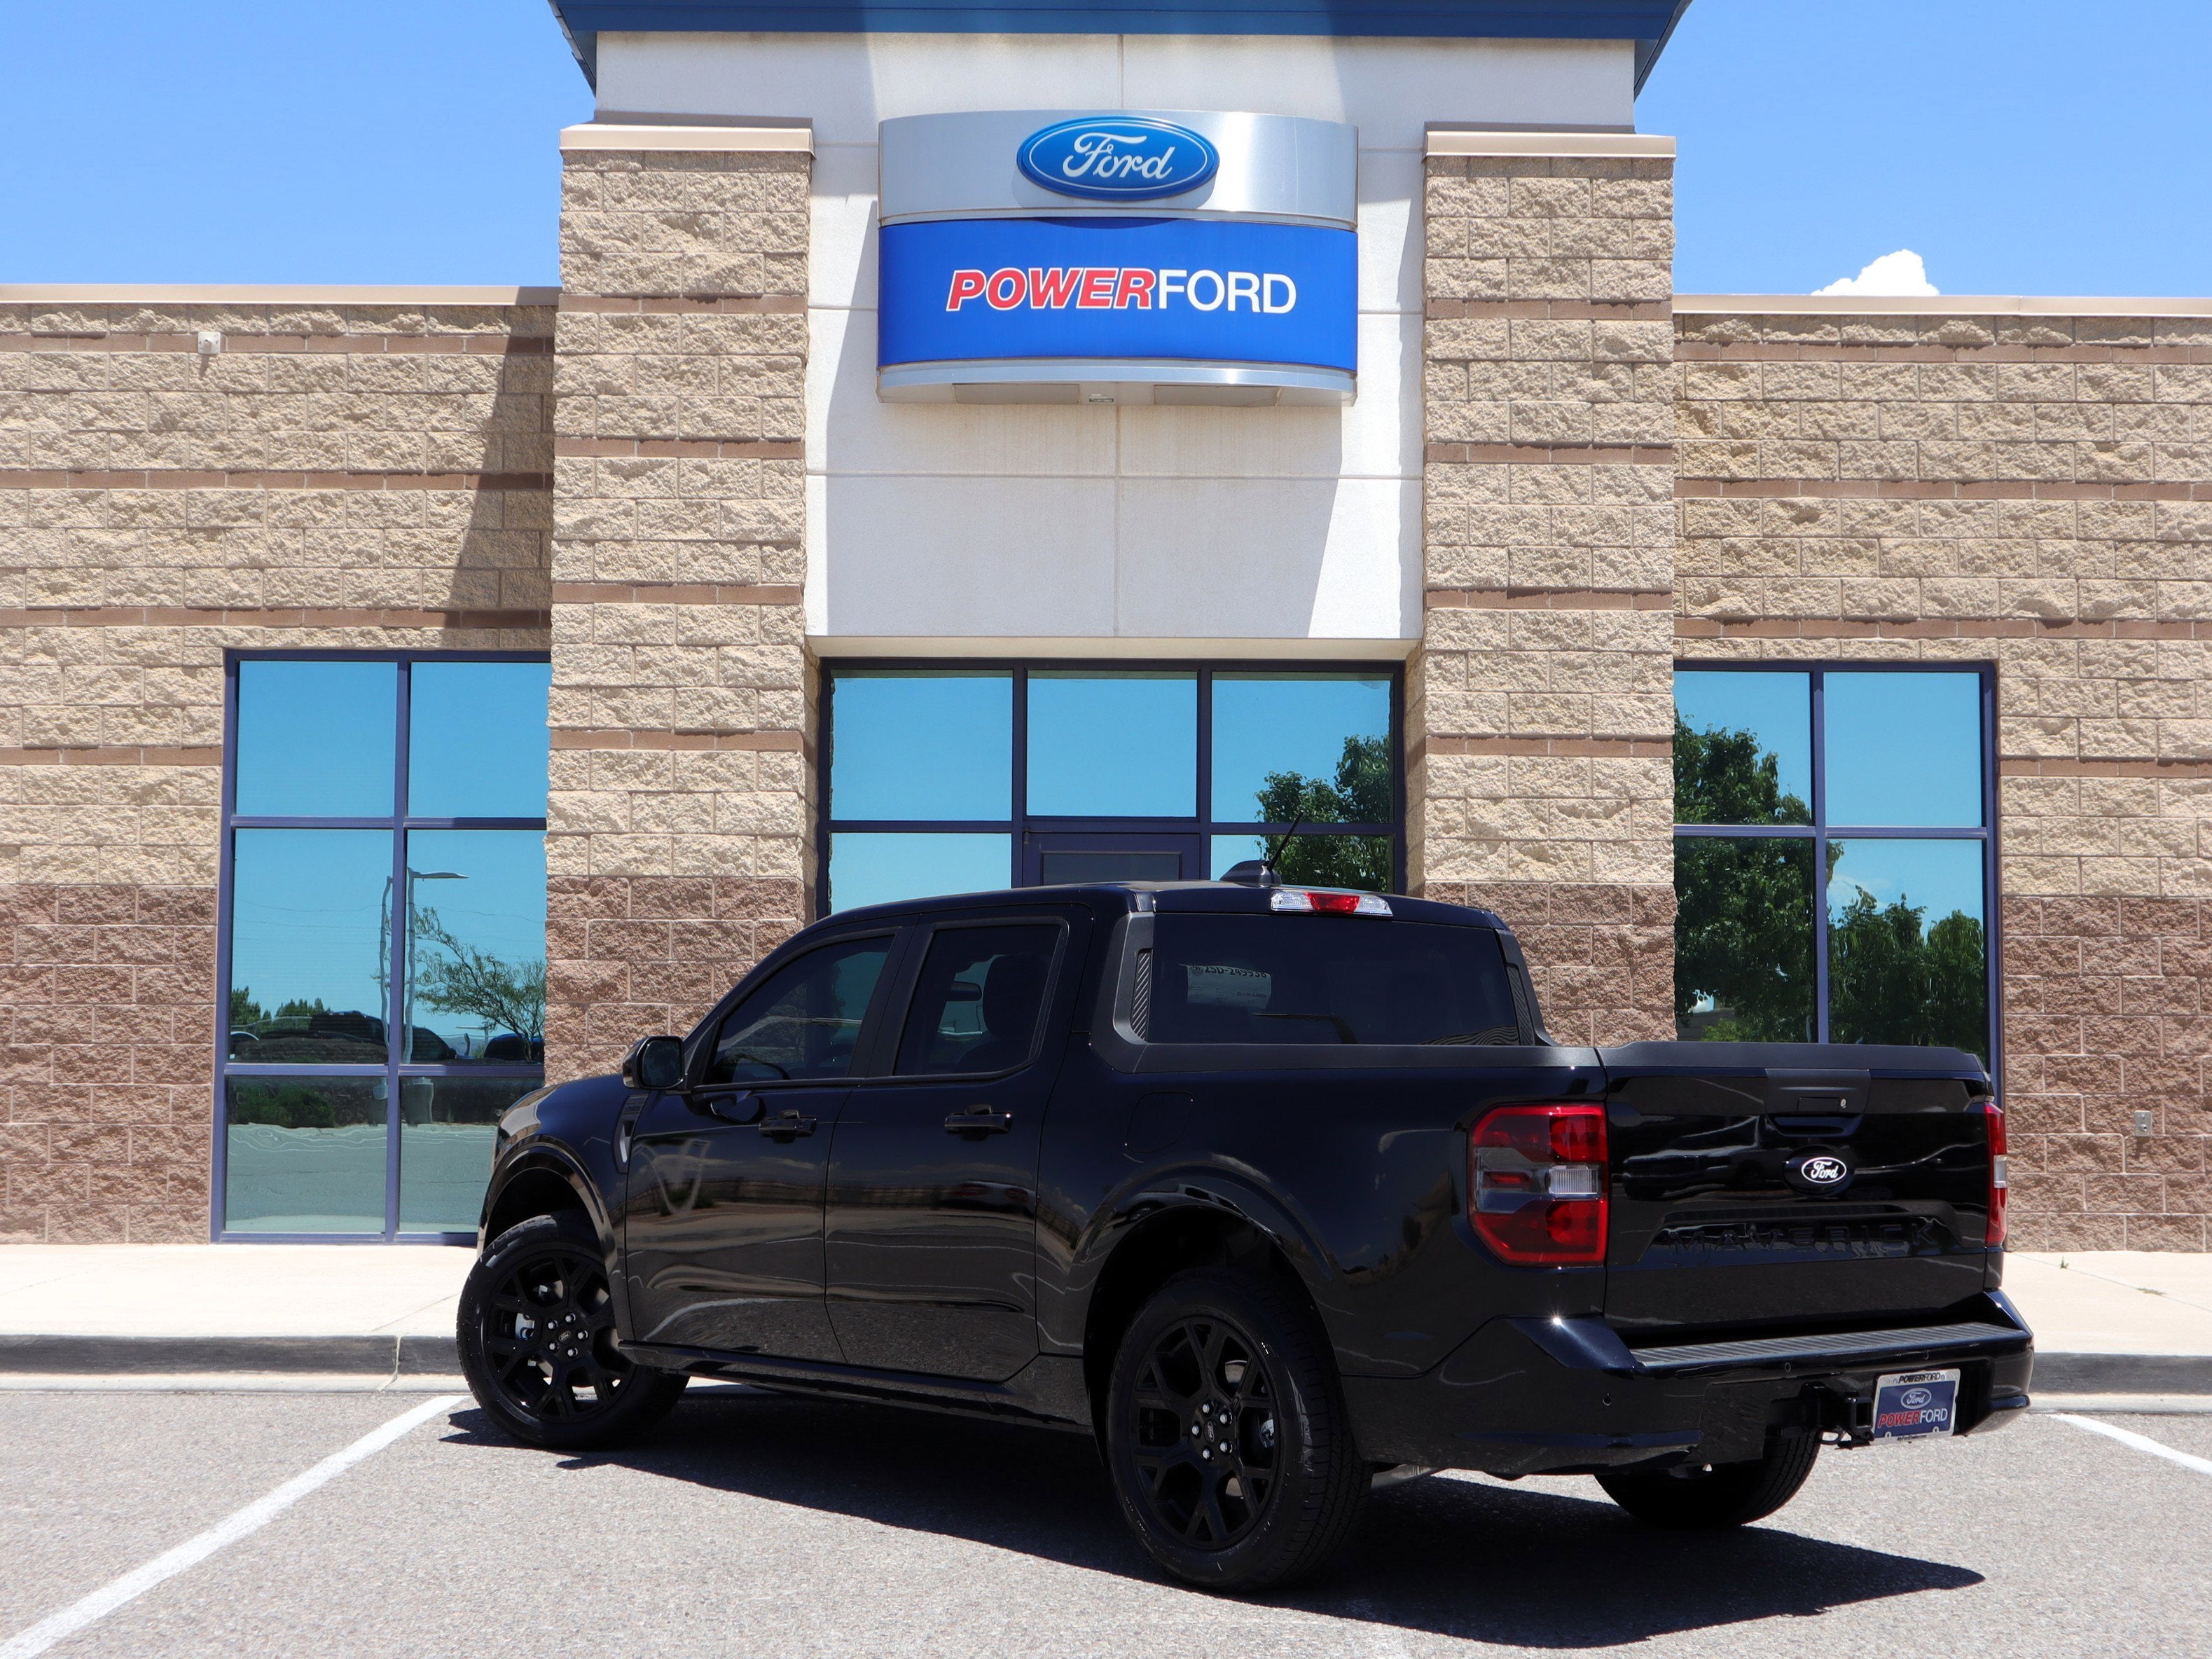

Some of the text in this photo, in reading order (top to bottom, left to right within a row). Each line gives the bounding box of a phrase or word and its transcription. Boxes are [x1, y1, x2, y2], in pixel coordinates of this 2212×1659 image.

[1063, 132, 1175, 179] Ford
[946, 267, 1297, 314] POWERFORD
[1810, 1160, 1839, 1180] Ford
[1670, 1222, 1939, 1253] MAVERICK
[1898, 1372, 1941, 1384] POWERFORD
[1907, 1392, 1926, 1405] Ford
[1878, 1408, 1948, 1429] POWERFORD
